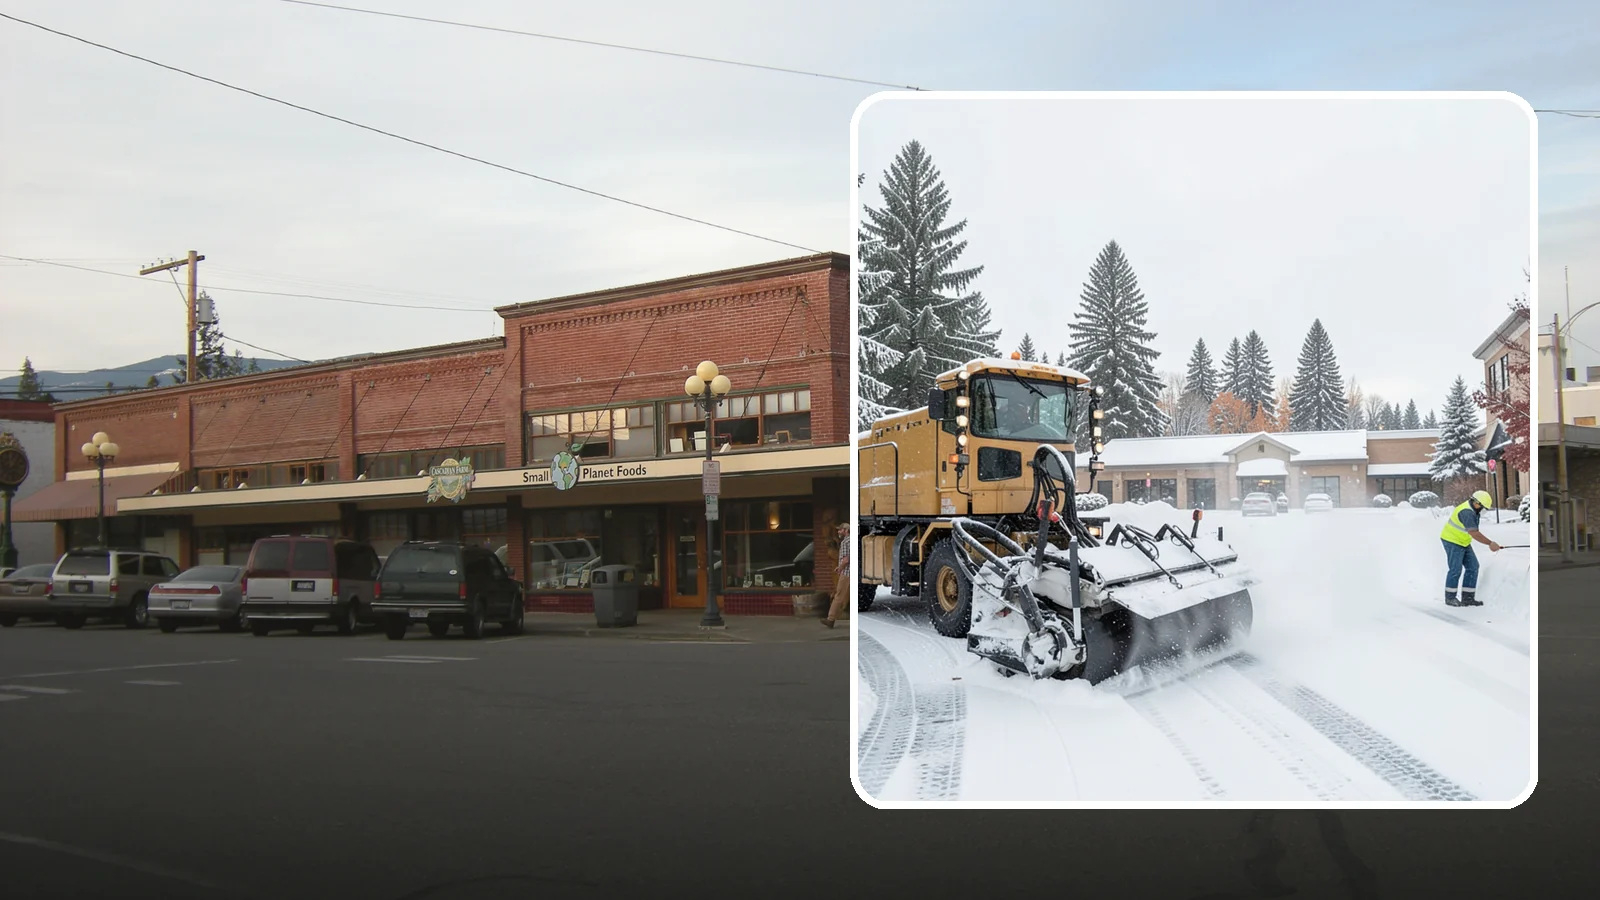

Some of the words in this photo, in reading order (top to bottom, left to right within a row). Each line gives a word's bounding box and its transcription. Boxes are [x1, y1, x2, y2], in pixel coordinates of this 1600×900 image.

[523, 471, 549, 483] Small
[582, 467, 614, 479] Planet
[617, 464, 647, 477] Foods
